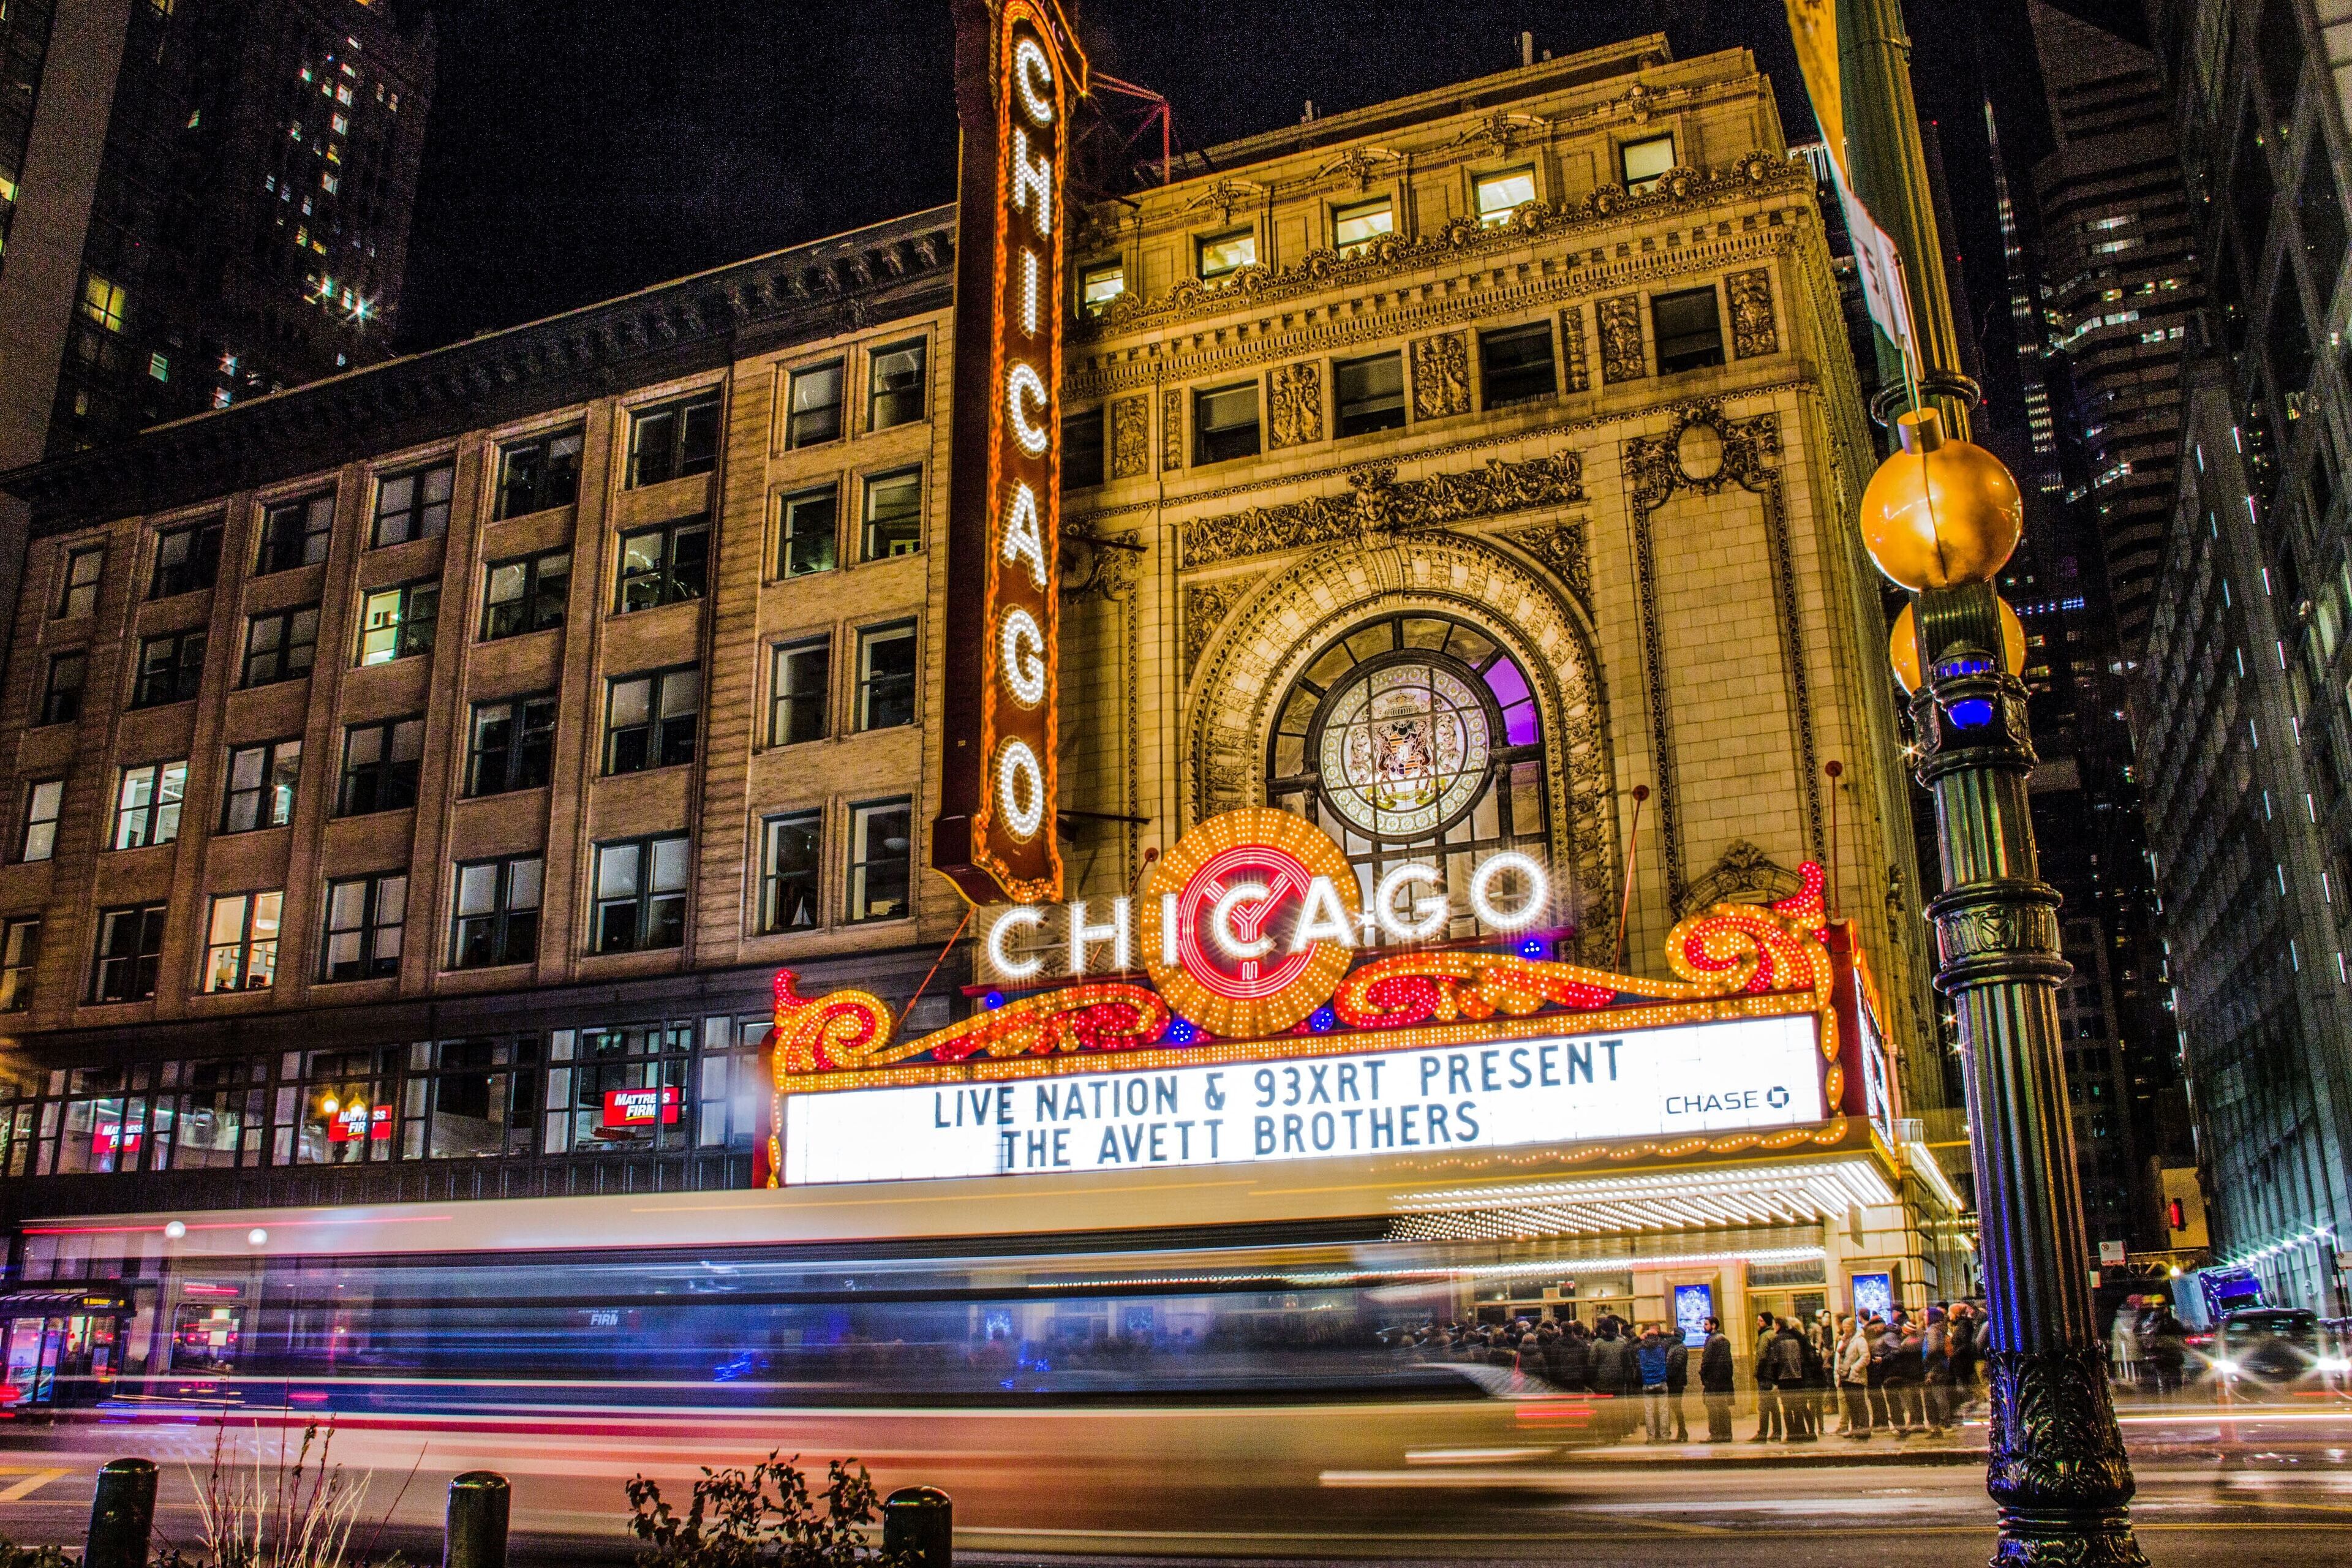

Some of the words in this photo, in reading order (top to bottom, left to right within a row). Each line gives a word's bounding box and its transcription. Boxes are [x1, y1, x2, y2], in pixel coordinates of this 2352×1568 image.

[1000, 39, 1052, 837] CHICAGO
[987, 851, 1548, 978] CHICAGO
[935, 1086, 1014, 1128] LIVE
[1036, 1075, 1178, 1122] NATION
[1205, 1072, 1226, 1110] &
[1254, 1059, 1386, 1109] 93XRT
[1419, 1039, 1624, 1097] PRESENT
[614, 1092, 671, 1106] MATTRES
[626, 1104, 657, 1117] FIRM
[1666, 1090, 1760, 1114] CHASE
[348, 1121, 375, 1133] FIR
[1001, 1127, 1071, 1168] THE
[1097, 1118, 1224, 1164] AVETT
[1254, 1100, 1480, 1156] BROTHERS
[110, 1134, 134, 1145] FIM
